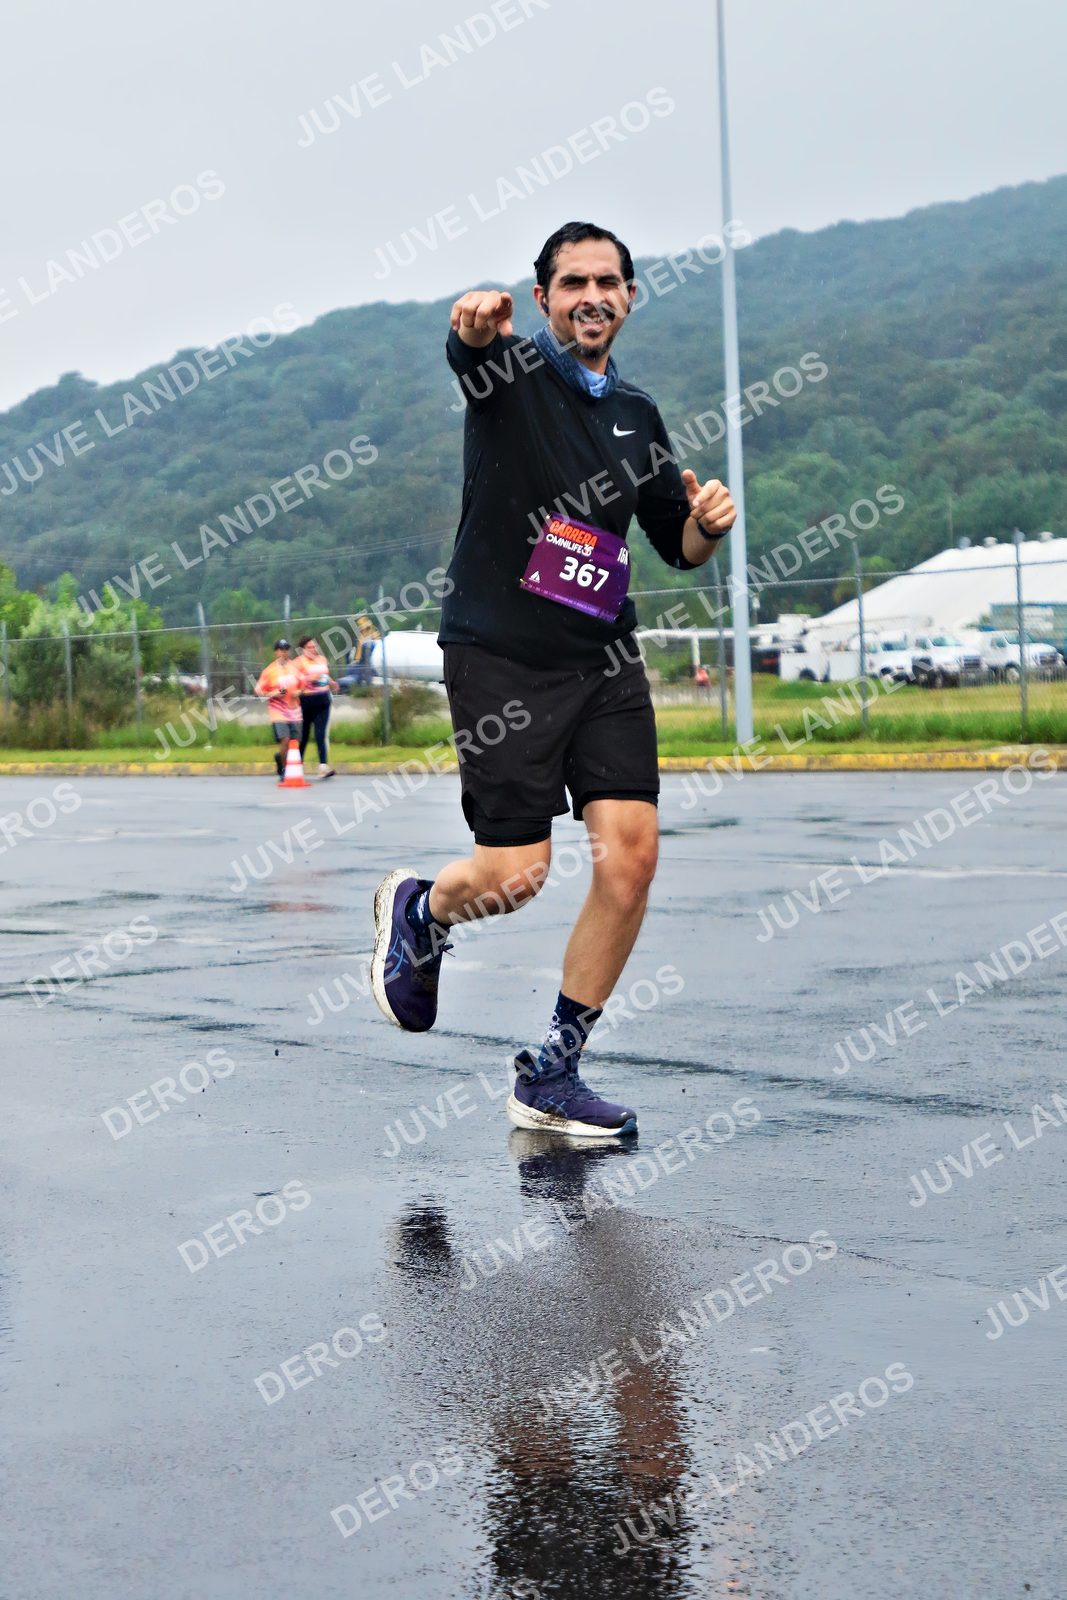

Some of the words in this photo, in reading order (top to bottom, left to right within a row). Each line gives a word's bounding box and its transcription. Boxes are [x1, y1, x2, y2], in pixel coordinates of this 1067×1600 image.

[545, 533, 584, 555] OMNILIFE
[548, 520, 598, 548] CARRERA
[559, 556, 610, 592] 367
